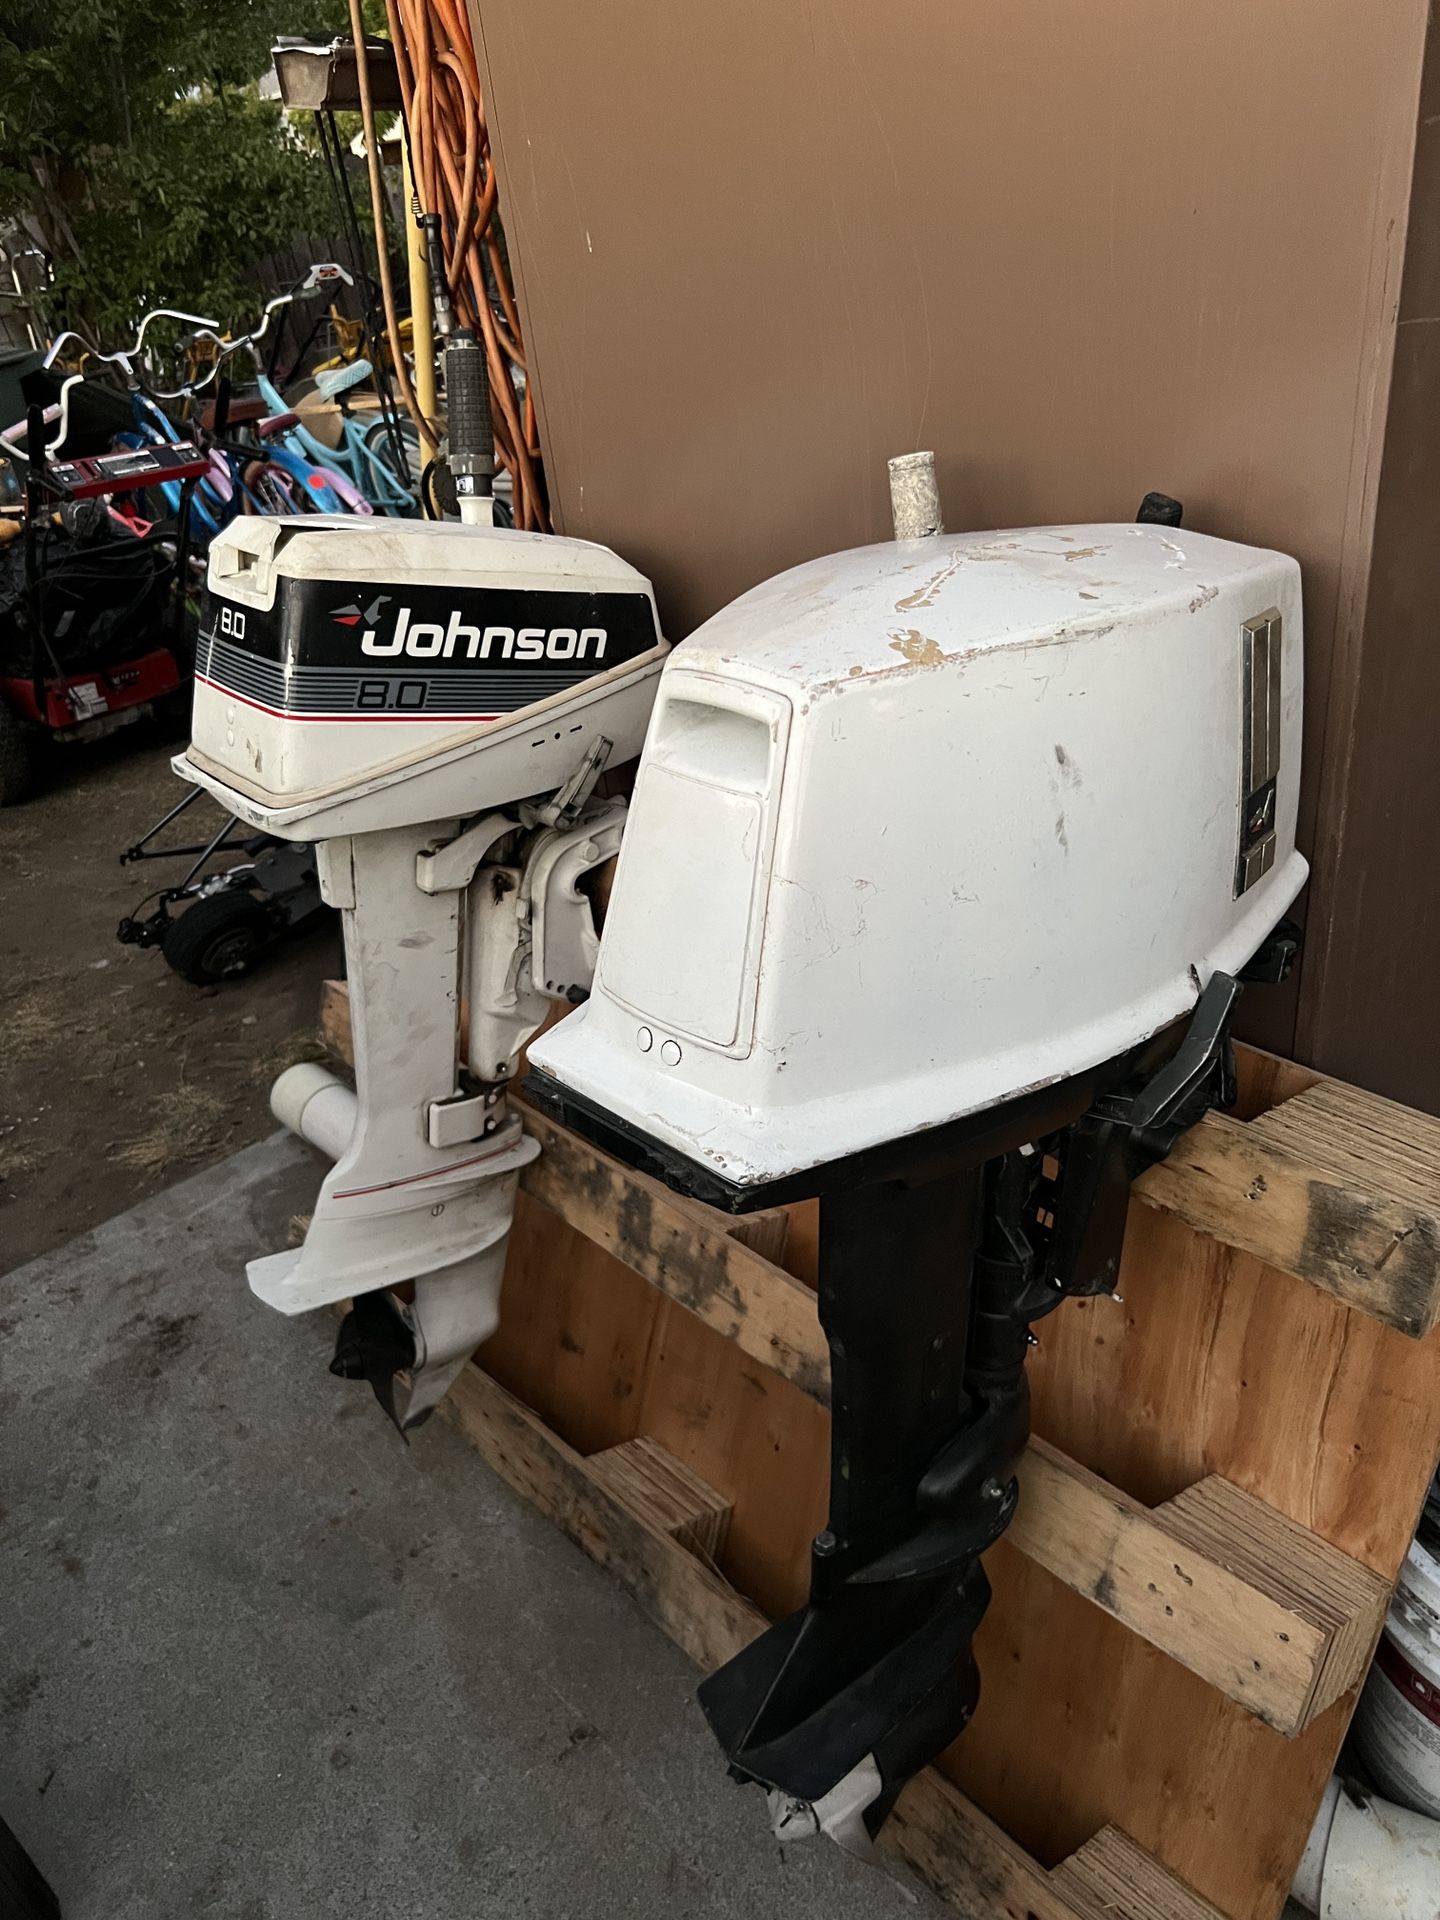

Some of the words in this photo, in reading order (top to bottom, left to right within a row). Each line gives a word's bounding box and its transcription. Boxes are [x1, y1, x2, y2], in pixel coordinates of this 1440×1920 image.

[221, 606, 246, 640] 8.0
[361, 607, 608, 660] Johnson
[357, 680, 428, 709] 8.0
